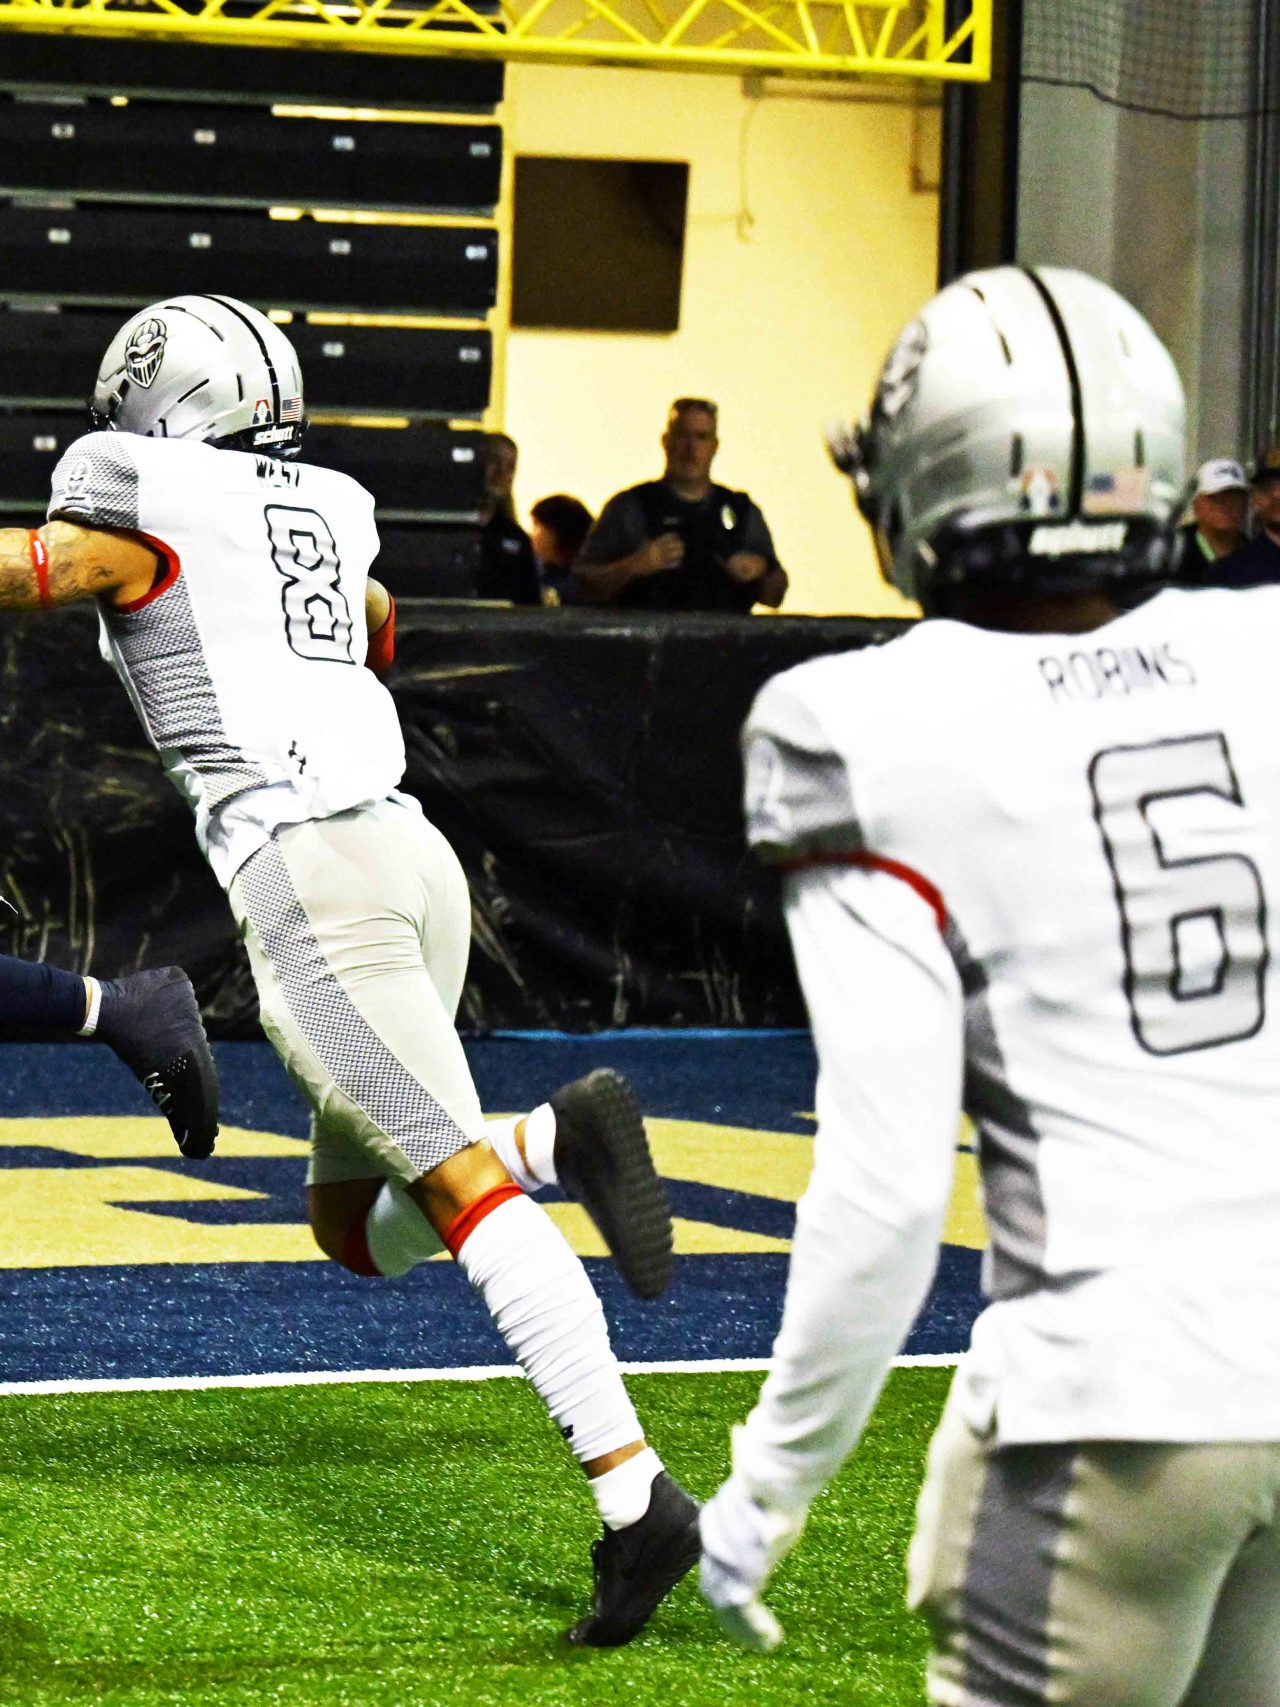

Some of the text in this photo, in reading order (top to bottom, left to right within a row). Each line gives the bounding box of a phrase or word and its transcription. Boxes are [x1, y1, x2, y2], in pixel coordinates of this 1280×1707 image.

[264, 503, 358, 665] 8
[1037, 642, 1197, 703] ROBINS
[1087, 731, 1269, 1056] 6
